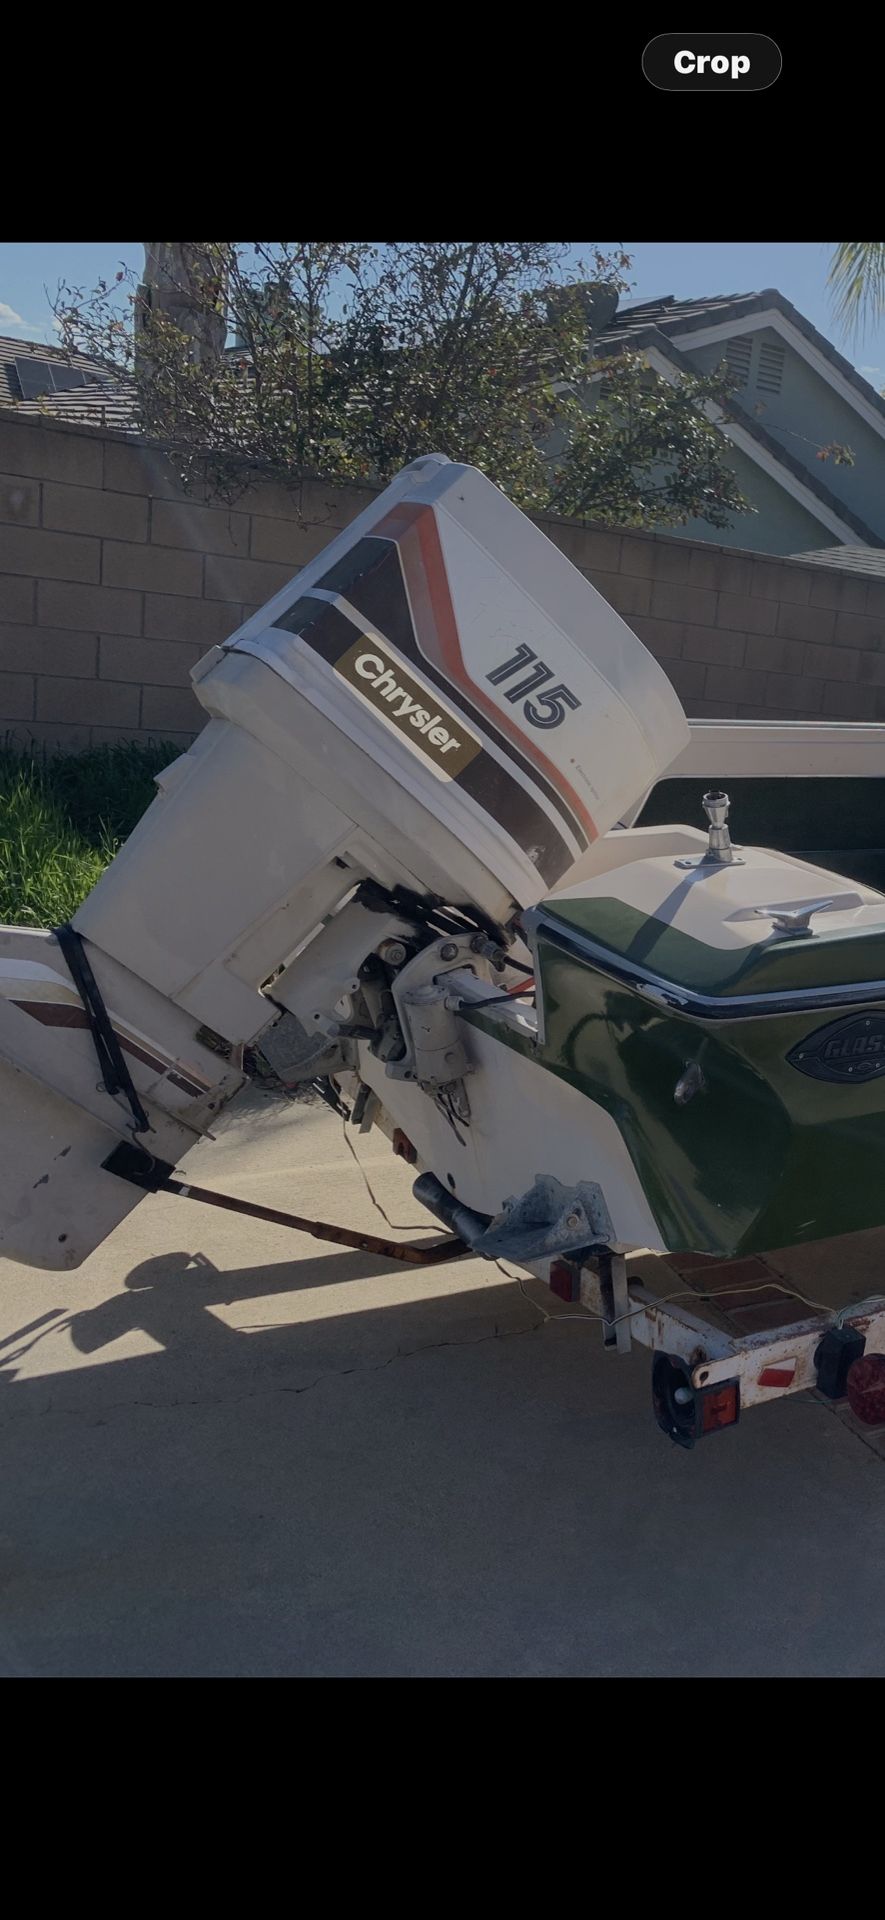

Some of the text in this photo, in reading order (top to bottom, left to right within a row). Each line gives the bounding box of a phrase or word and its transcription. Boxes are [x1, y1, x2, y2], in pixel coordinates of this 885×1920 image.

[354, 654, 461, 754] Chrysler
[485, 643, 582, 729] 115
[824, 1034, 885, 1058] GLAS
